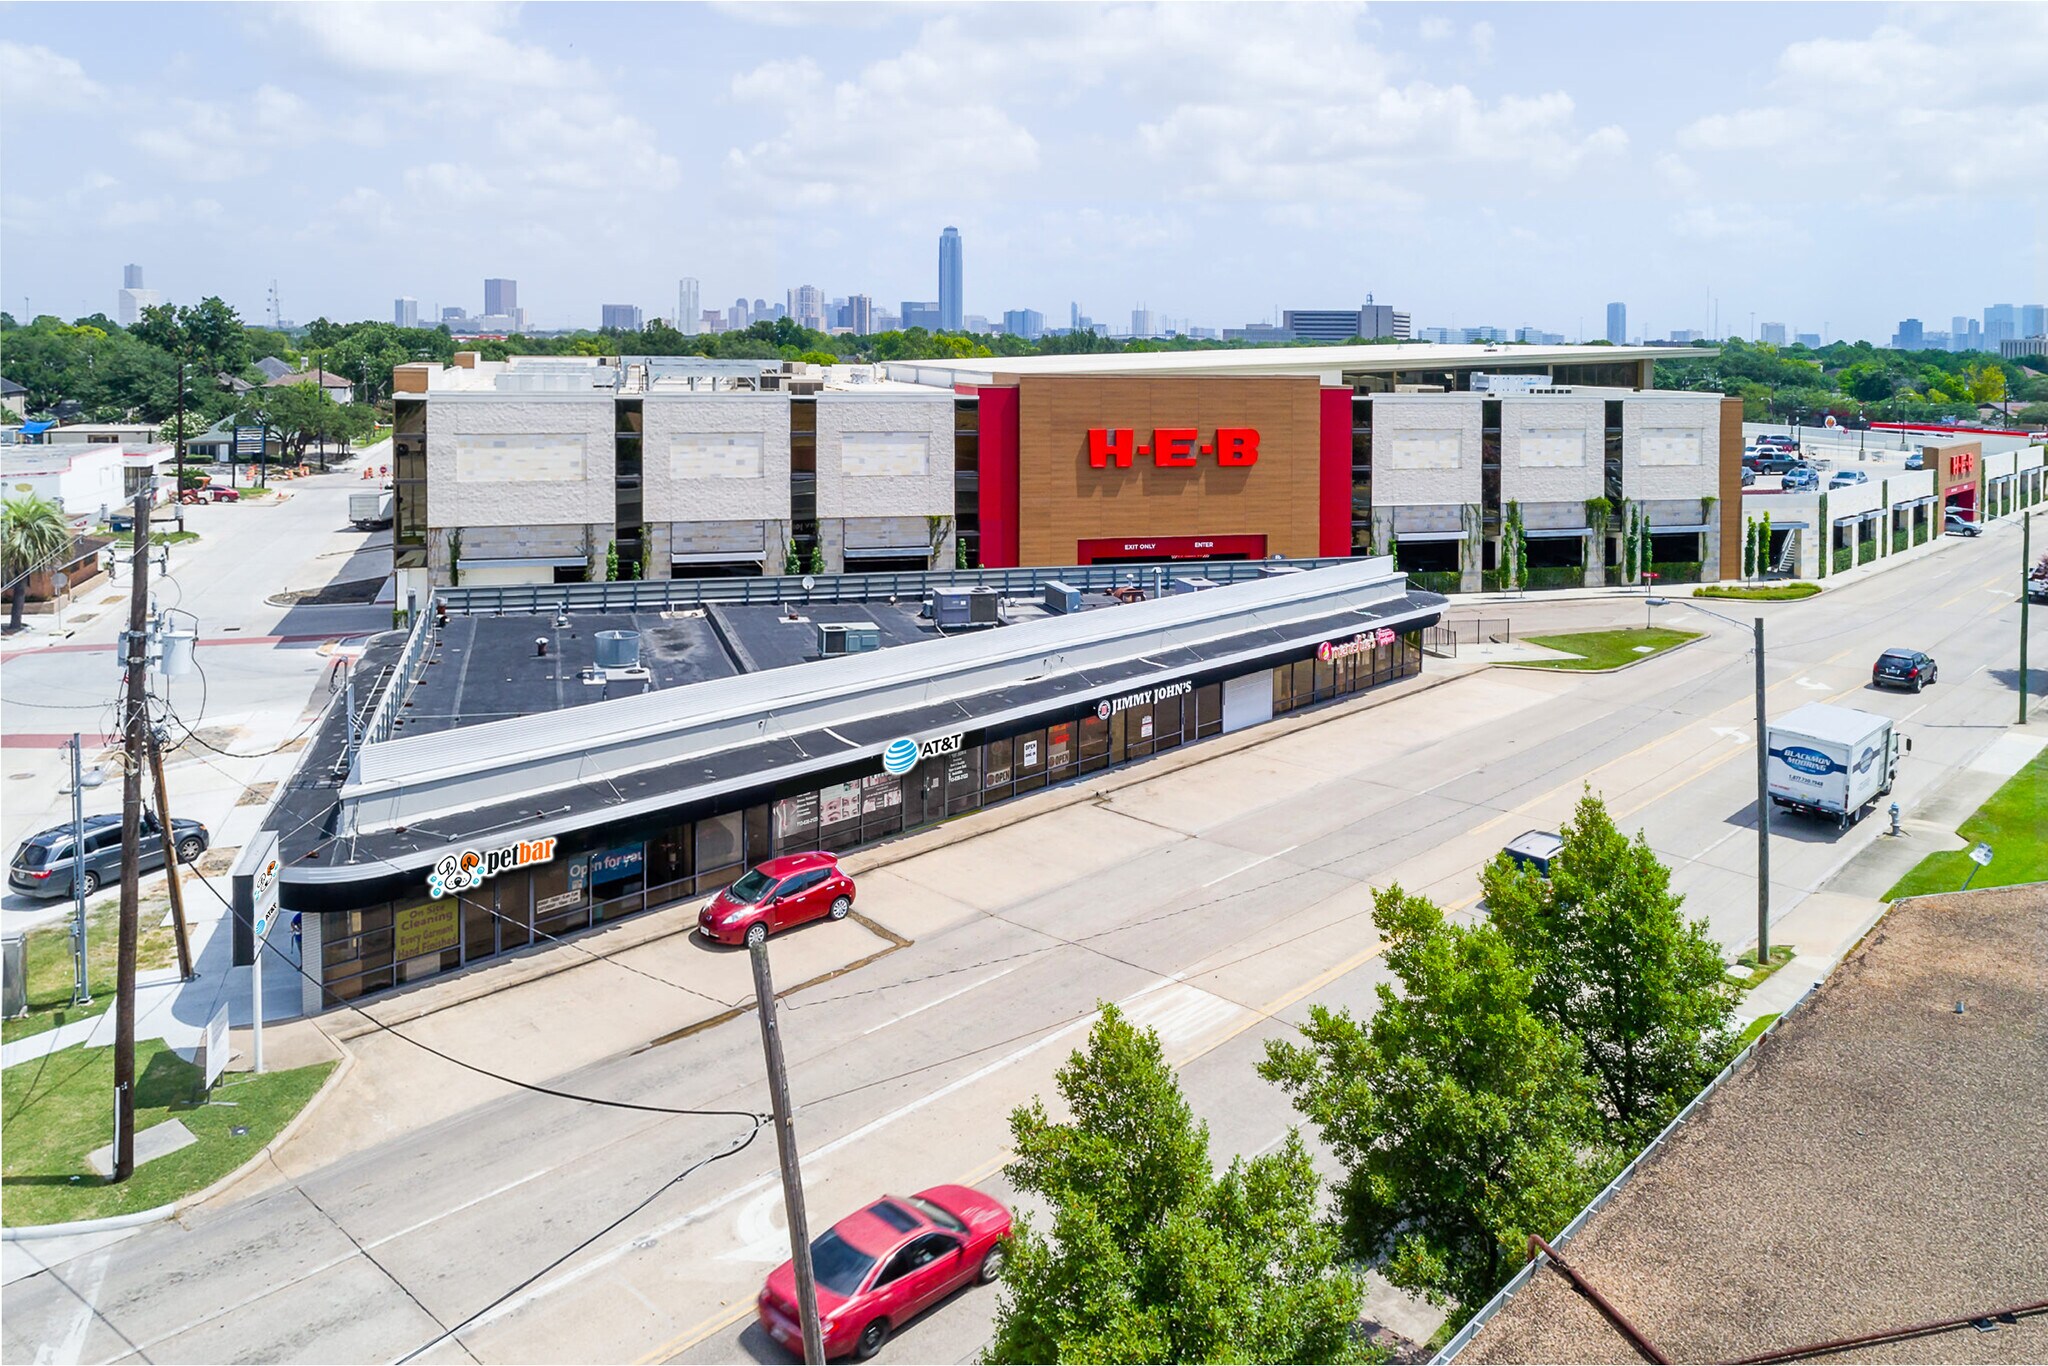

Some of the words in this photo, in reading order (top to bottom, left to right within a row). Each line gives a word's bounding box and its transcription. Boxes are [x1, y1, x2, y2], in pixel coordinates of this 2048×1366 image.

[1088, 427, 1260, 468] H-E-B
[1112, 690, 1152, 715] JIMMY
[1153, 681, 1192, 704] JOHN'S
[922, 733, 962, 757] AT&T
[1025, 743, 1036, 751] OPEN
[1055, 753, 1069, 765] OPEN
[1783, 749, 1831, 766] BLACKMON
[1786, 757, 1827, 771] MOORING
[994, 769, 1011, 783] OPEN
[487, 838, 554, 875] petbar
[569, 861, 602, 878] Opn
[604, 856, 622, 869] for
[265, 902, 277, 921] AT&T
[401, 911, 453, 931] Cleaning
[410, 909, 424, 919] On
[400, 933, 421, 948] Every
[423, 925, 454, 939] Garment
[422, 934, 457, 952] Finished
